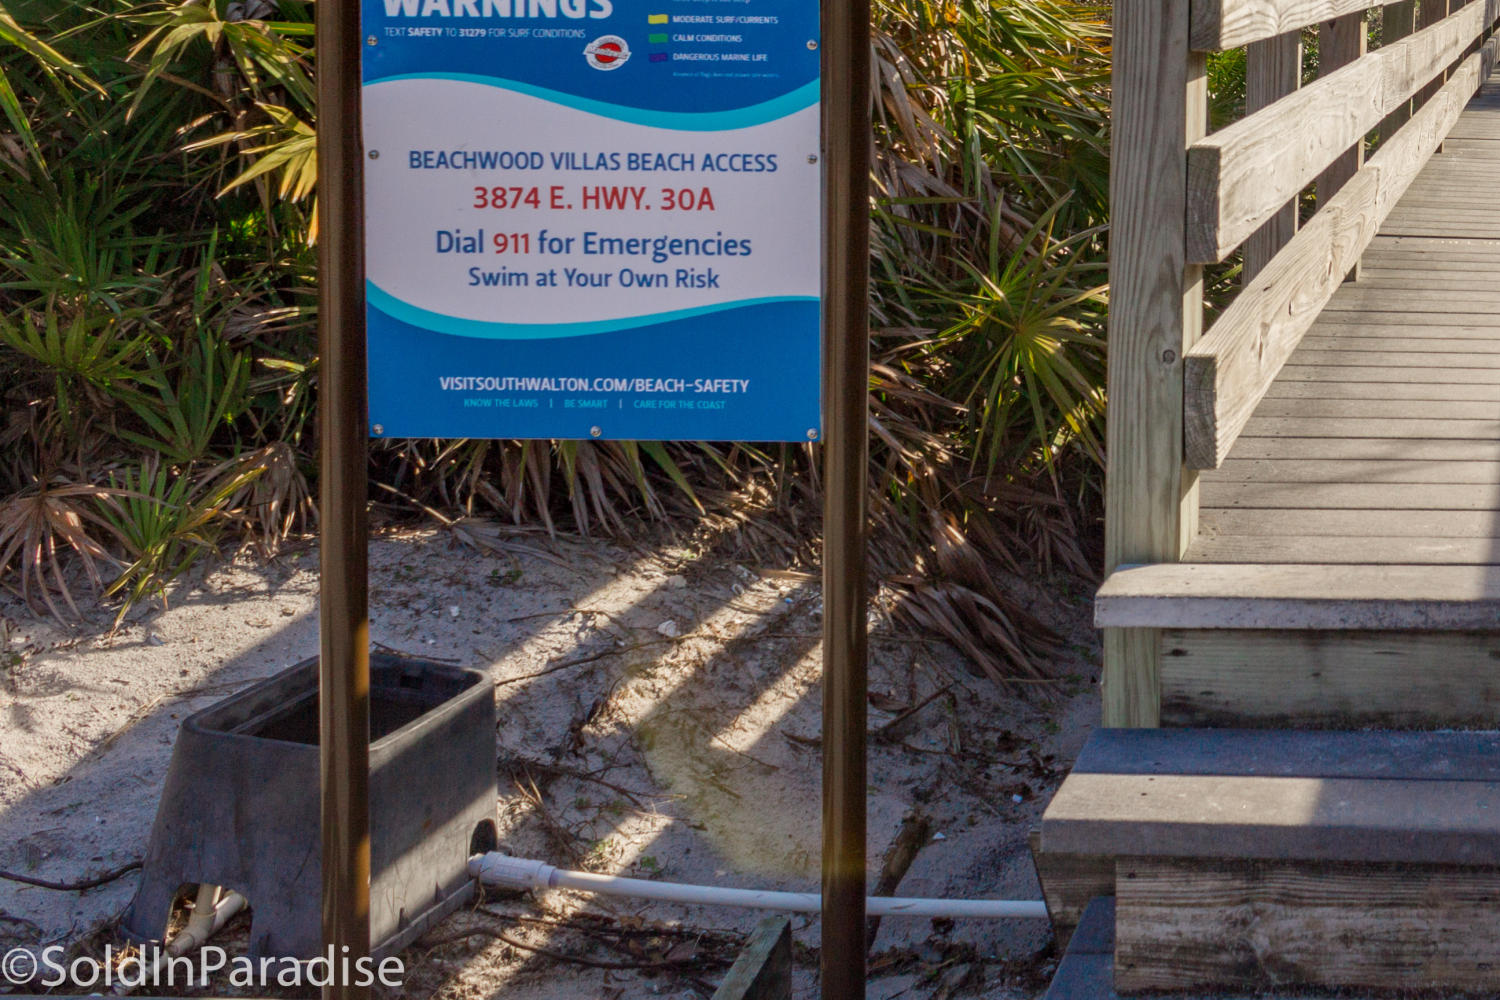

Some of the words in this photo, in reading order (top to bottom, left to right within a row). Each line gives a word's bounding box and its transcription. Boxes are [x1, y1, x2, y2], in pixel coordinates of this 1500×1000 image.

[672, 15, 714, 24] MODERATE
[384, 27, 405, 37] TEXT
[407, 27, 443, 37] SAFETY
[445, 27, 458, 37] TO
[459, 28, 486, 38] 31279
[488, 28, 506, 38] FOR
[508, 28, 530, 38] SURF
[532, 29, 586, 39] CONDITIONS
[672, 34, 695, 42] CALM
[695, 34, 743, 43] CONDITIONS
[672, 53, 719, 61] DANGEROUS
[721, 53, 750, 61] MARINE
[751, 53, 768, 62] LIFE
[409, 150, 544, 170] BEACHWOOD
[550, 152, 621, 171] VILLAS
[627, 153, 695, 172] BEACH
[701, 154, 778, 173] ACCESS
[473, 186, 541, 209] 3874
[549, 186, 573, 210] E.
[582, 187, 651, 211] HWY.
[660, 187, 715, 211] 30A
[436, 229, 484, 254] Dial
[493, 233, 530, 254] 911
[538, 231, 575, 255] for
[583, 232, 752, 263] Emergencies
[468, 267, 529, 287] Swim
[535, 270, 557, 287] at
[564, 268, 613, 288] Your
[619, 268, 669, 288] Own
[675, 268, 720, 289] Risk
[439, 376, 750, 393] VISITSOUTHWALTON.COM/BEACH-SAFETY
[463, 399, 492, 408] KNOW
[495, 399, 511, 408] THE
[512, 399, 538, 408] LAWS
[564, 399, 576, 408] BE
[577, 399, 608, 409] SMART
[633, 399, 656, 409] CARE
[659, 399, 677, 409] FOR
[678, 400, 694, 409] THE
[696, 400, 725, 409] COAST
